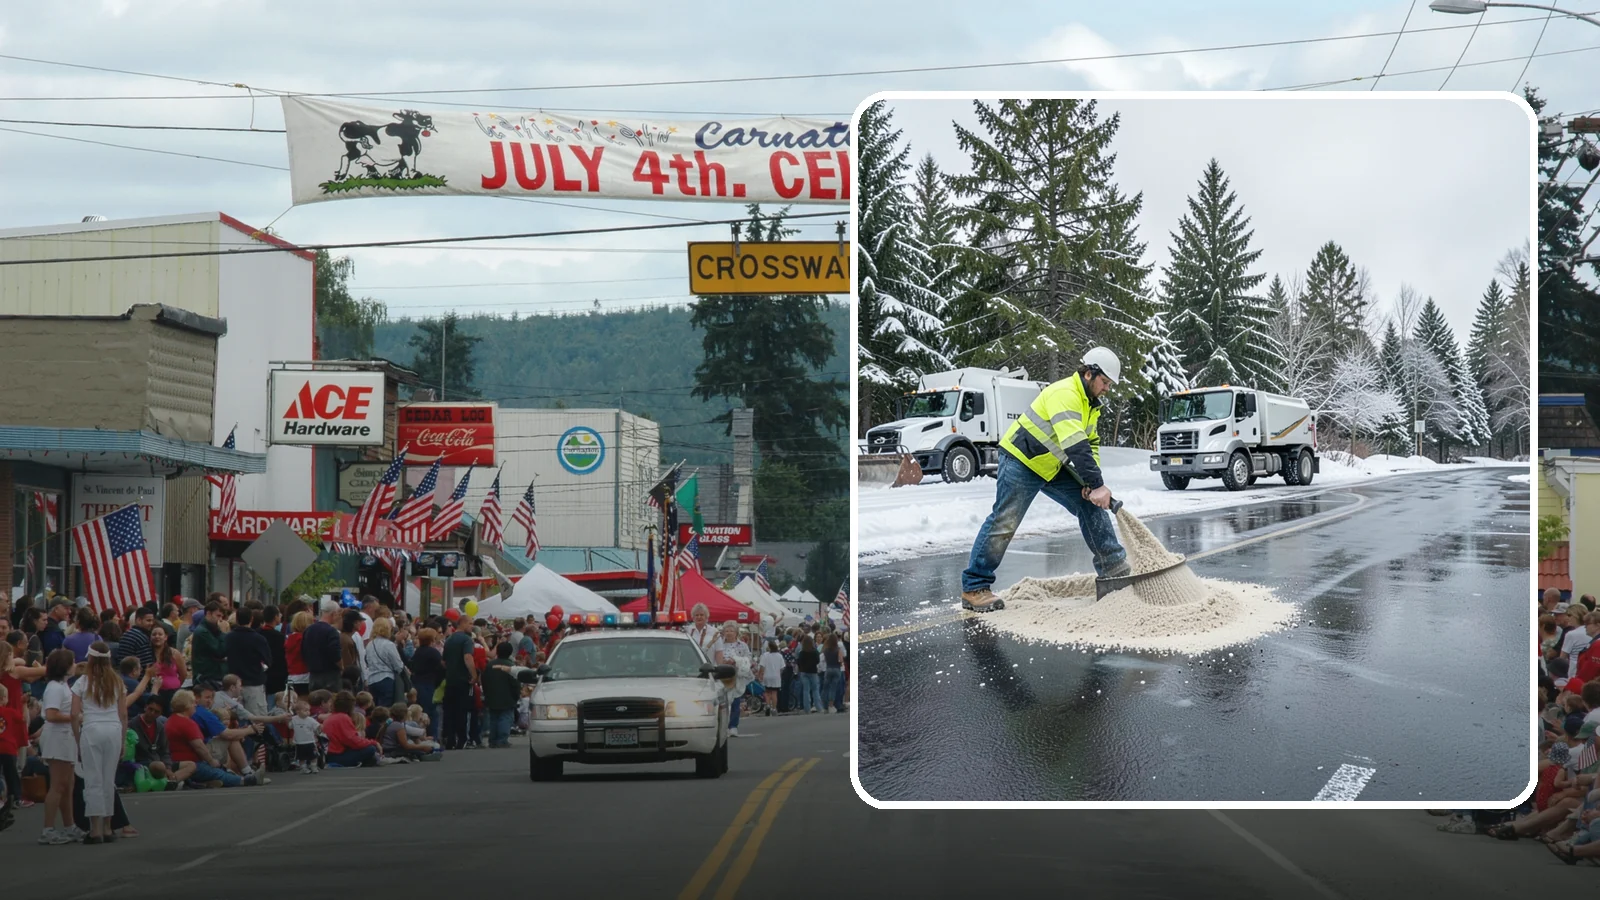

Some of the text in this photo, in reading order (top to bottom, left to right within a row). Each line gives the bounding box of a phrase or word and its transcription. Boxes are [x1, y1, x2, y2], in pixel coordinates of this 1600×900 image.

[481, 141, 604, 193] JULY
[632, 149, 746, 198] 4th.
[697, 255, 850, 279] CROSSWA
[283, 380, 373, 420] ACE
[406, 409, 452, 421] CEDAR
[283, 421, 371, 436] Hardware
[353, 467, 386, 480] Simpl
[83, 485, 155, 495] St. Vincent de Paul
[688, 526, 741, 535] CRNATION
[699, 535, 730, 543] GLASS
